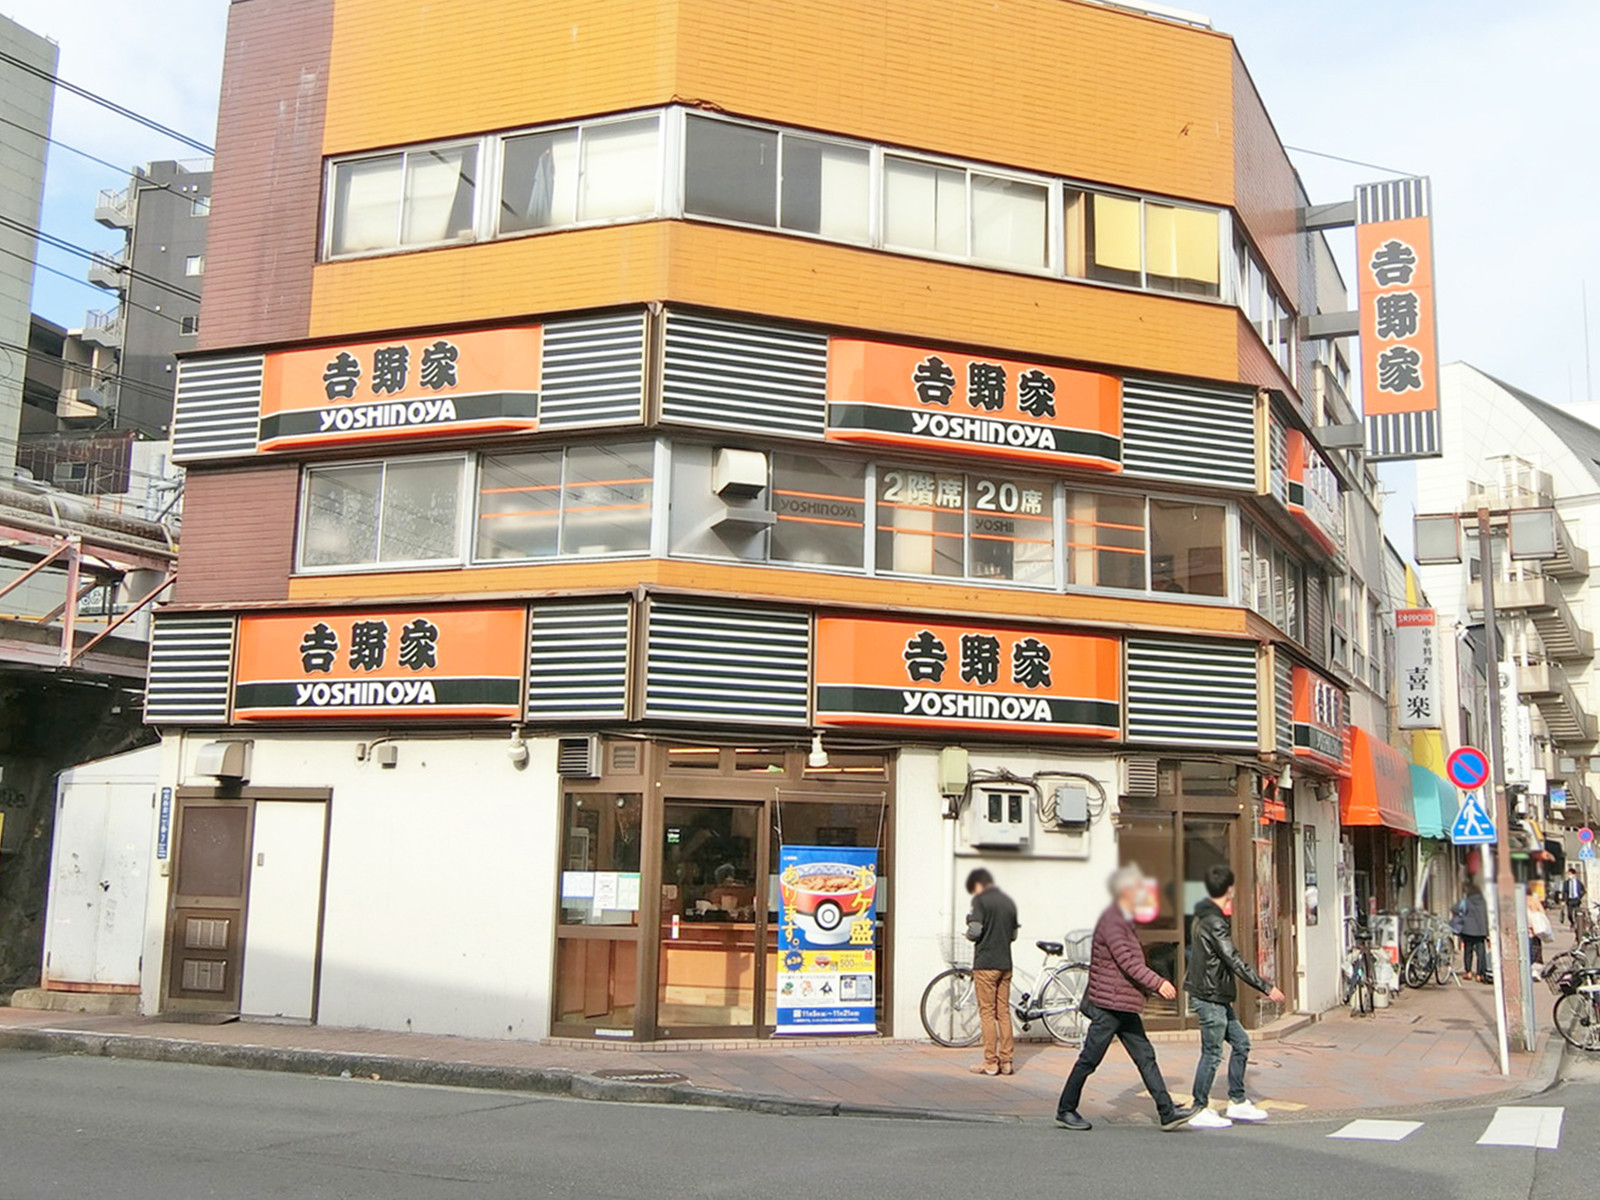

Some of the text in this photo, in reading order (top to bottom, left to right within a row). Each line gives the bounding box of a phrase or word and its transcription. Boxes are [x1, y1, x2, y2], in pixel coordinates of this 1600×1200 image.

[319, 399, 457, 431] YOSHINOYA
[911, 412, 1056, 451] YOSHINOYA
[883, 471, 1043, 515] 2階席 20席
[1422, 627, 1433, 666] 中華料理
[295, 681, 437, 706] YOSHINOYA
[902, 690, 1052, 722] YOSHINOYA
[1405, 666, 1432, 720] 喜楽
